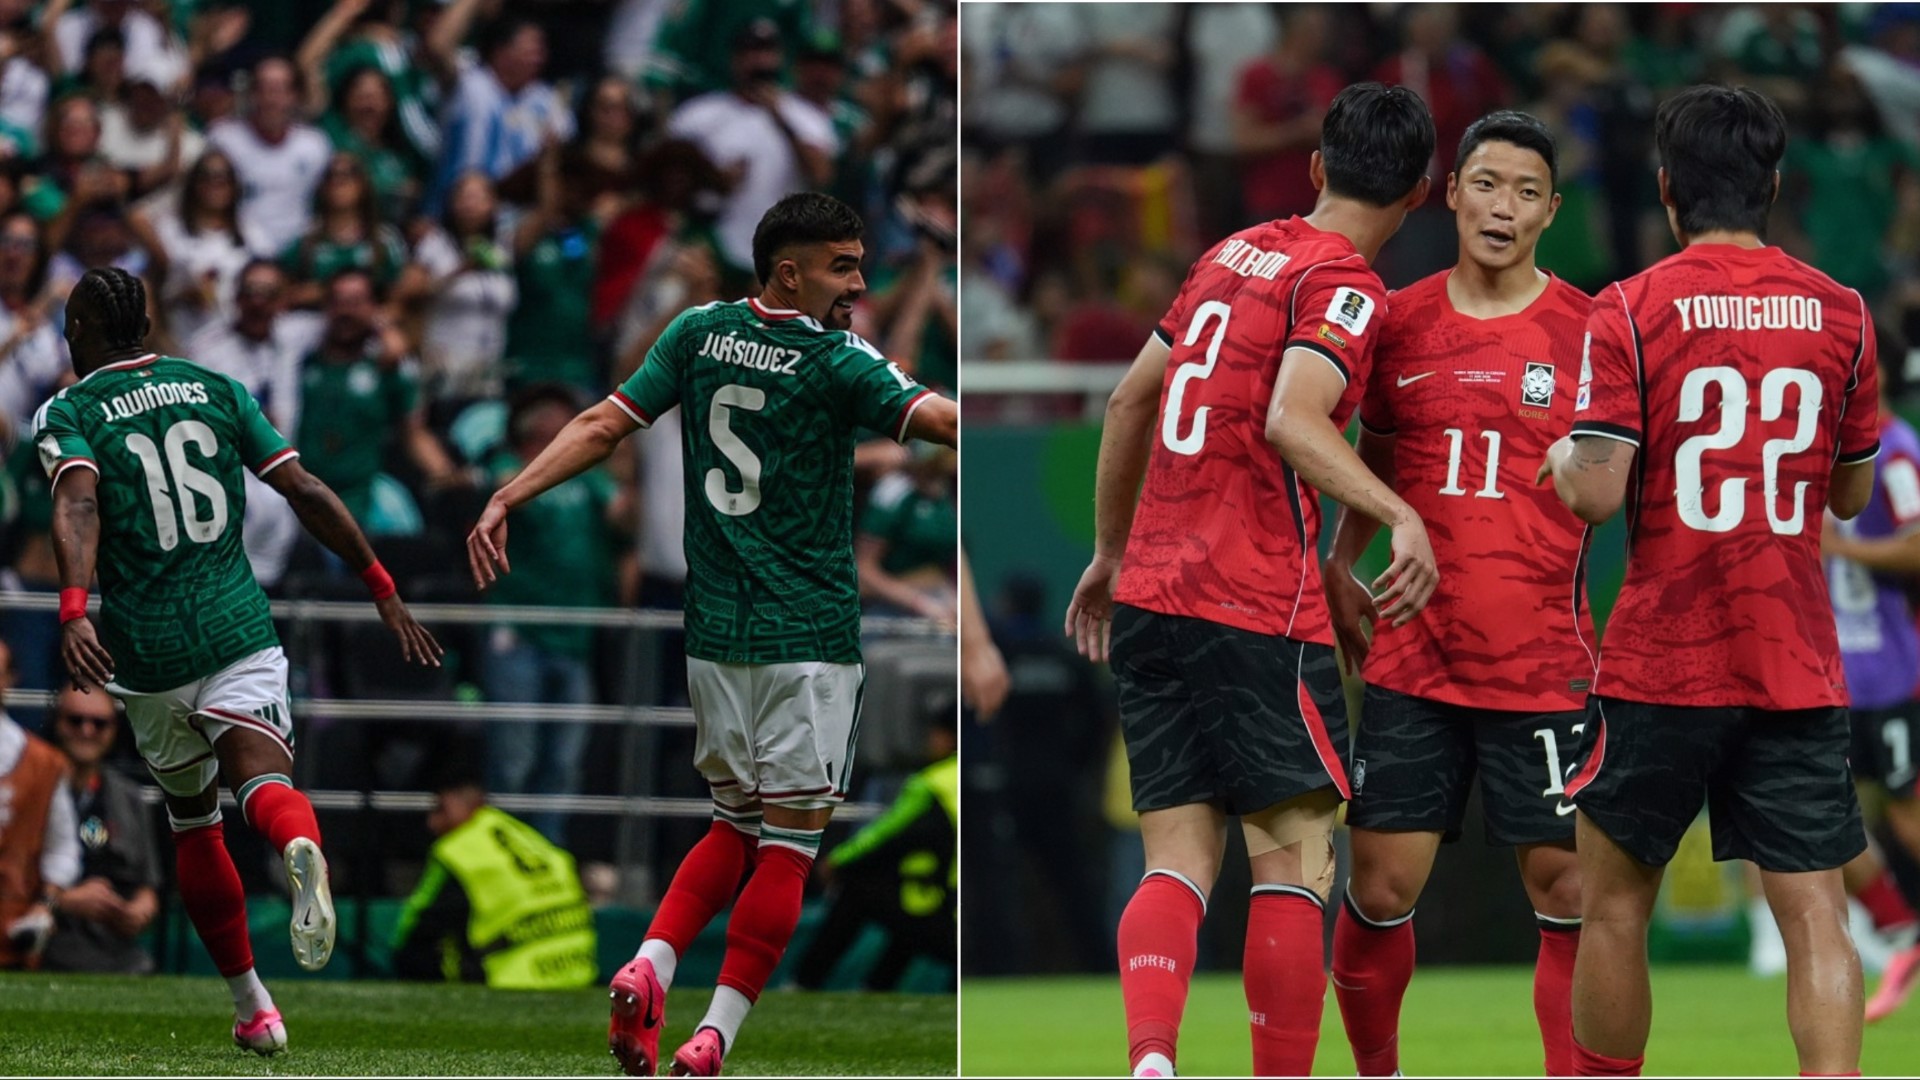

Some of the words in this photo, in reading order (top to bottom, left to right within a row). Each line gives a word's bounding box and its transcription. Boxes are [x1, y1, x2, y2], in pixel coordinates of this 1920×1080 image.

[1673, 295, 1822, 332] YOUNGWOO
[100, 381, 209, 422] J.QUIÑONES
[1162, 300, 1232, 455] 2
[704, 383, 766, 516] 5
[1517, 408, 1550, 420] KOREA
[125, 420, 228, 551] 16
[1438, 428, 1505, 499] 11
[1673, 366, 1824, 536] 22
[1129, 954, 1176, 973] KOREA
